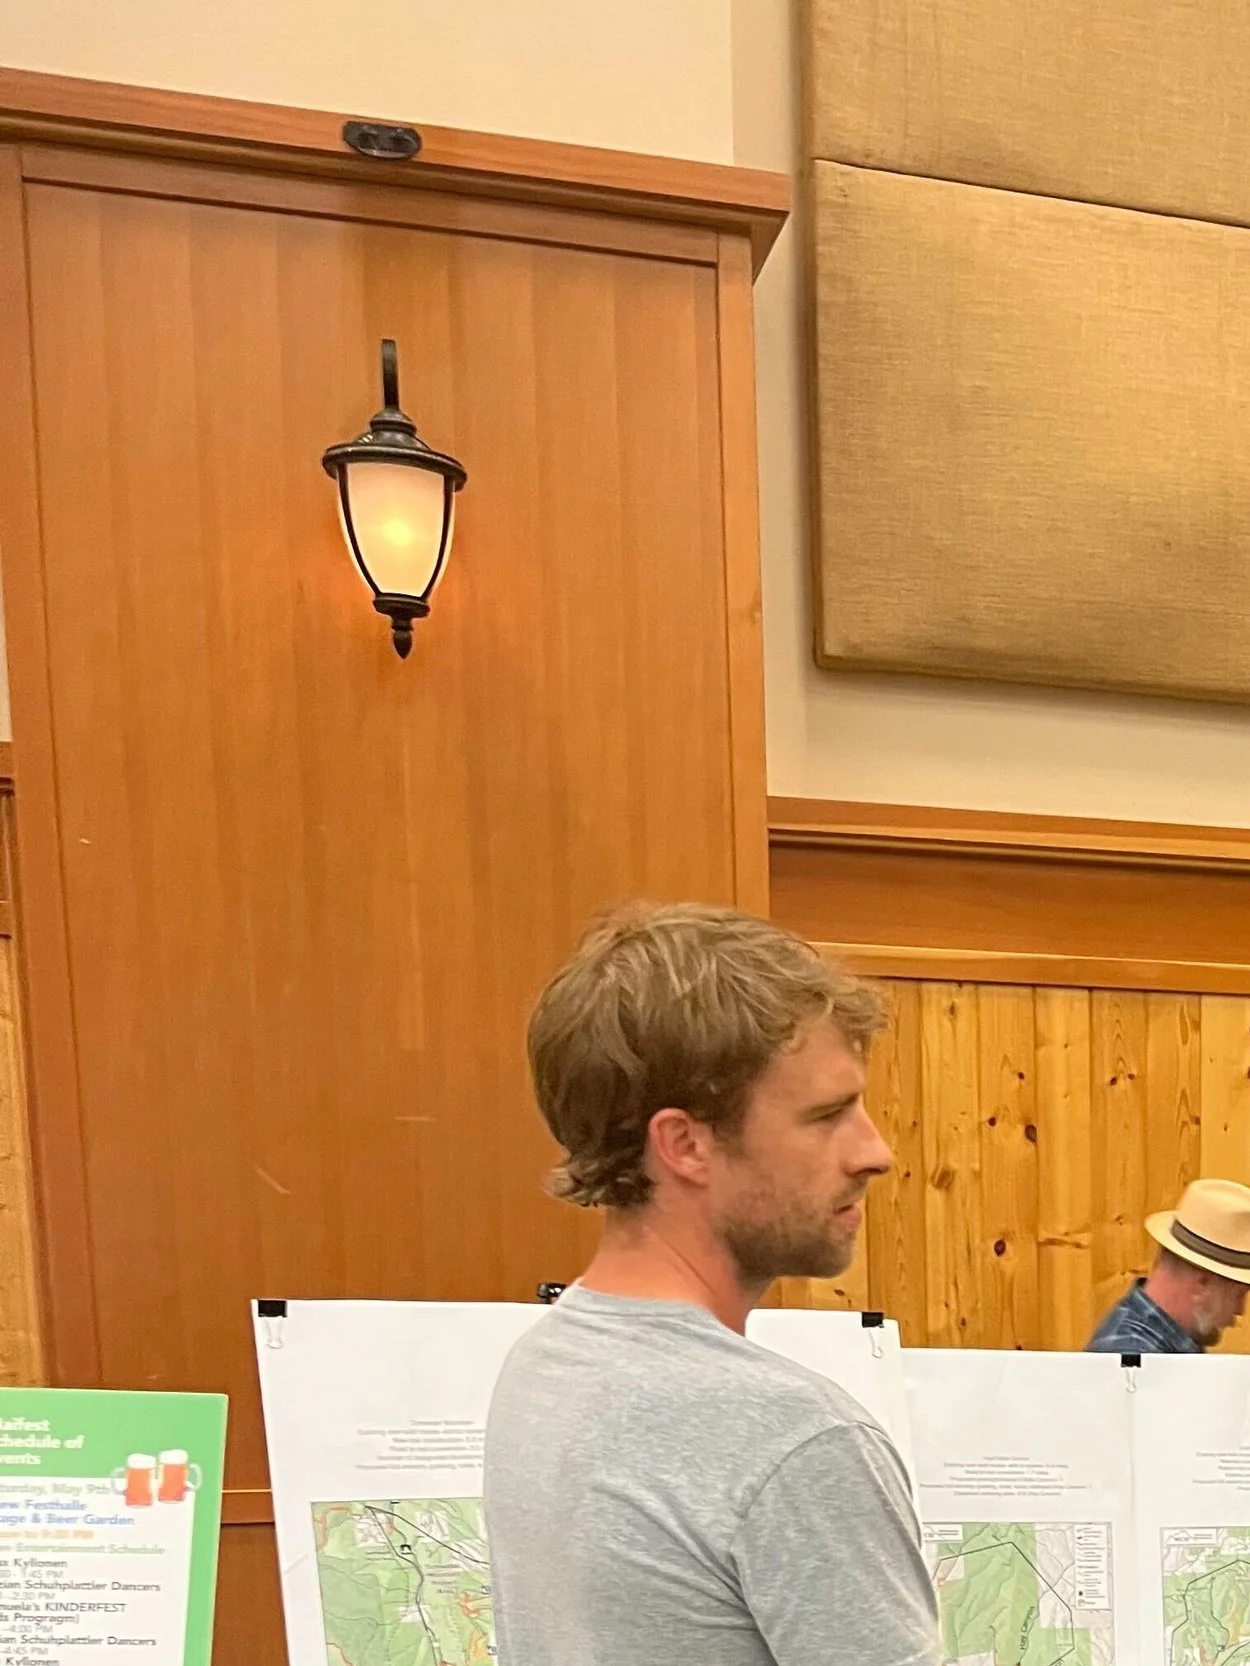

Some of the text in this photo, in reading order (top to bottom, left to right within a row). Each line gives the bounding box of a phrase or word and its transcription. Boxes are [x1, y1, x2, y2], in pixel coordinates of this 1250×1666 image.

[0, 1417, 50, 1431] aifest
[0, 1434, 85, 1449] chedule of
[0, 1453, 41, 1464] vents
[0, 1514, 26, 1526] tage
[47, 1514, 79, 1524] Beer
[84, 1514, 135, 1525] Garden
[111, 1581, 161, 1591] Dancers
[45, 1602, 127, 1612] KINDERFEST
[107, 1636, 157, 1646] Dancers
